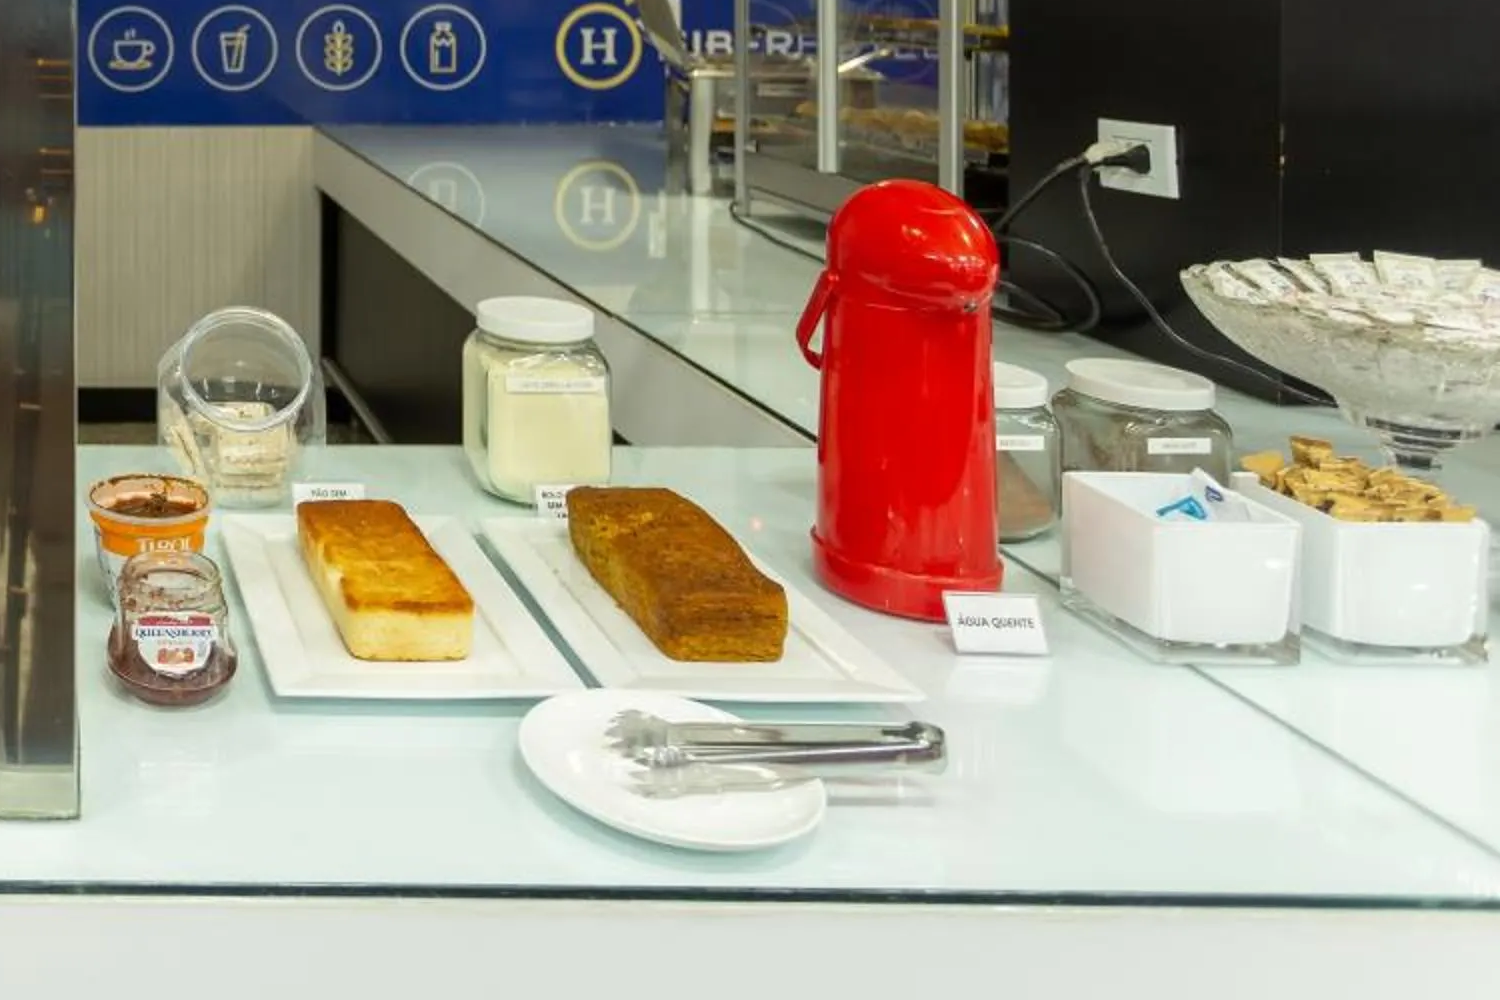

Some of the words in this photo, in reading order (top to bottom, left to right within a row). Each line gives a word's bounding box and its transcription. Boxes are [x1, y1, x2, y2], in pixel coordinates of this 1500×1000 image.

[580, 27, 618, 65] H
[957, 612, 990, 629] ÁGUA
[991, 616, 1035, 630] QUENTE
